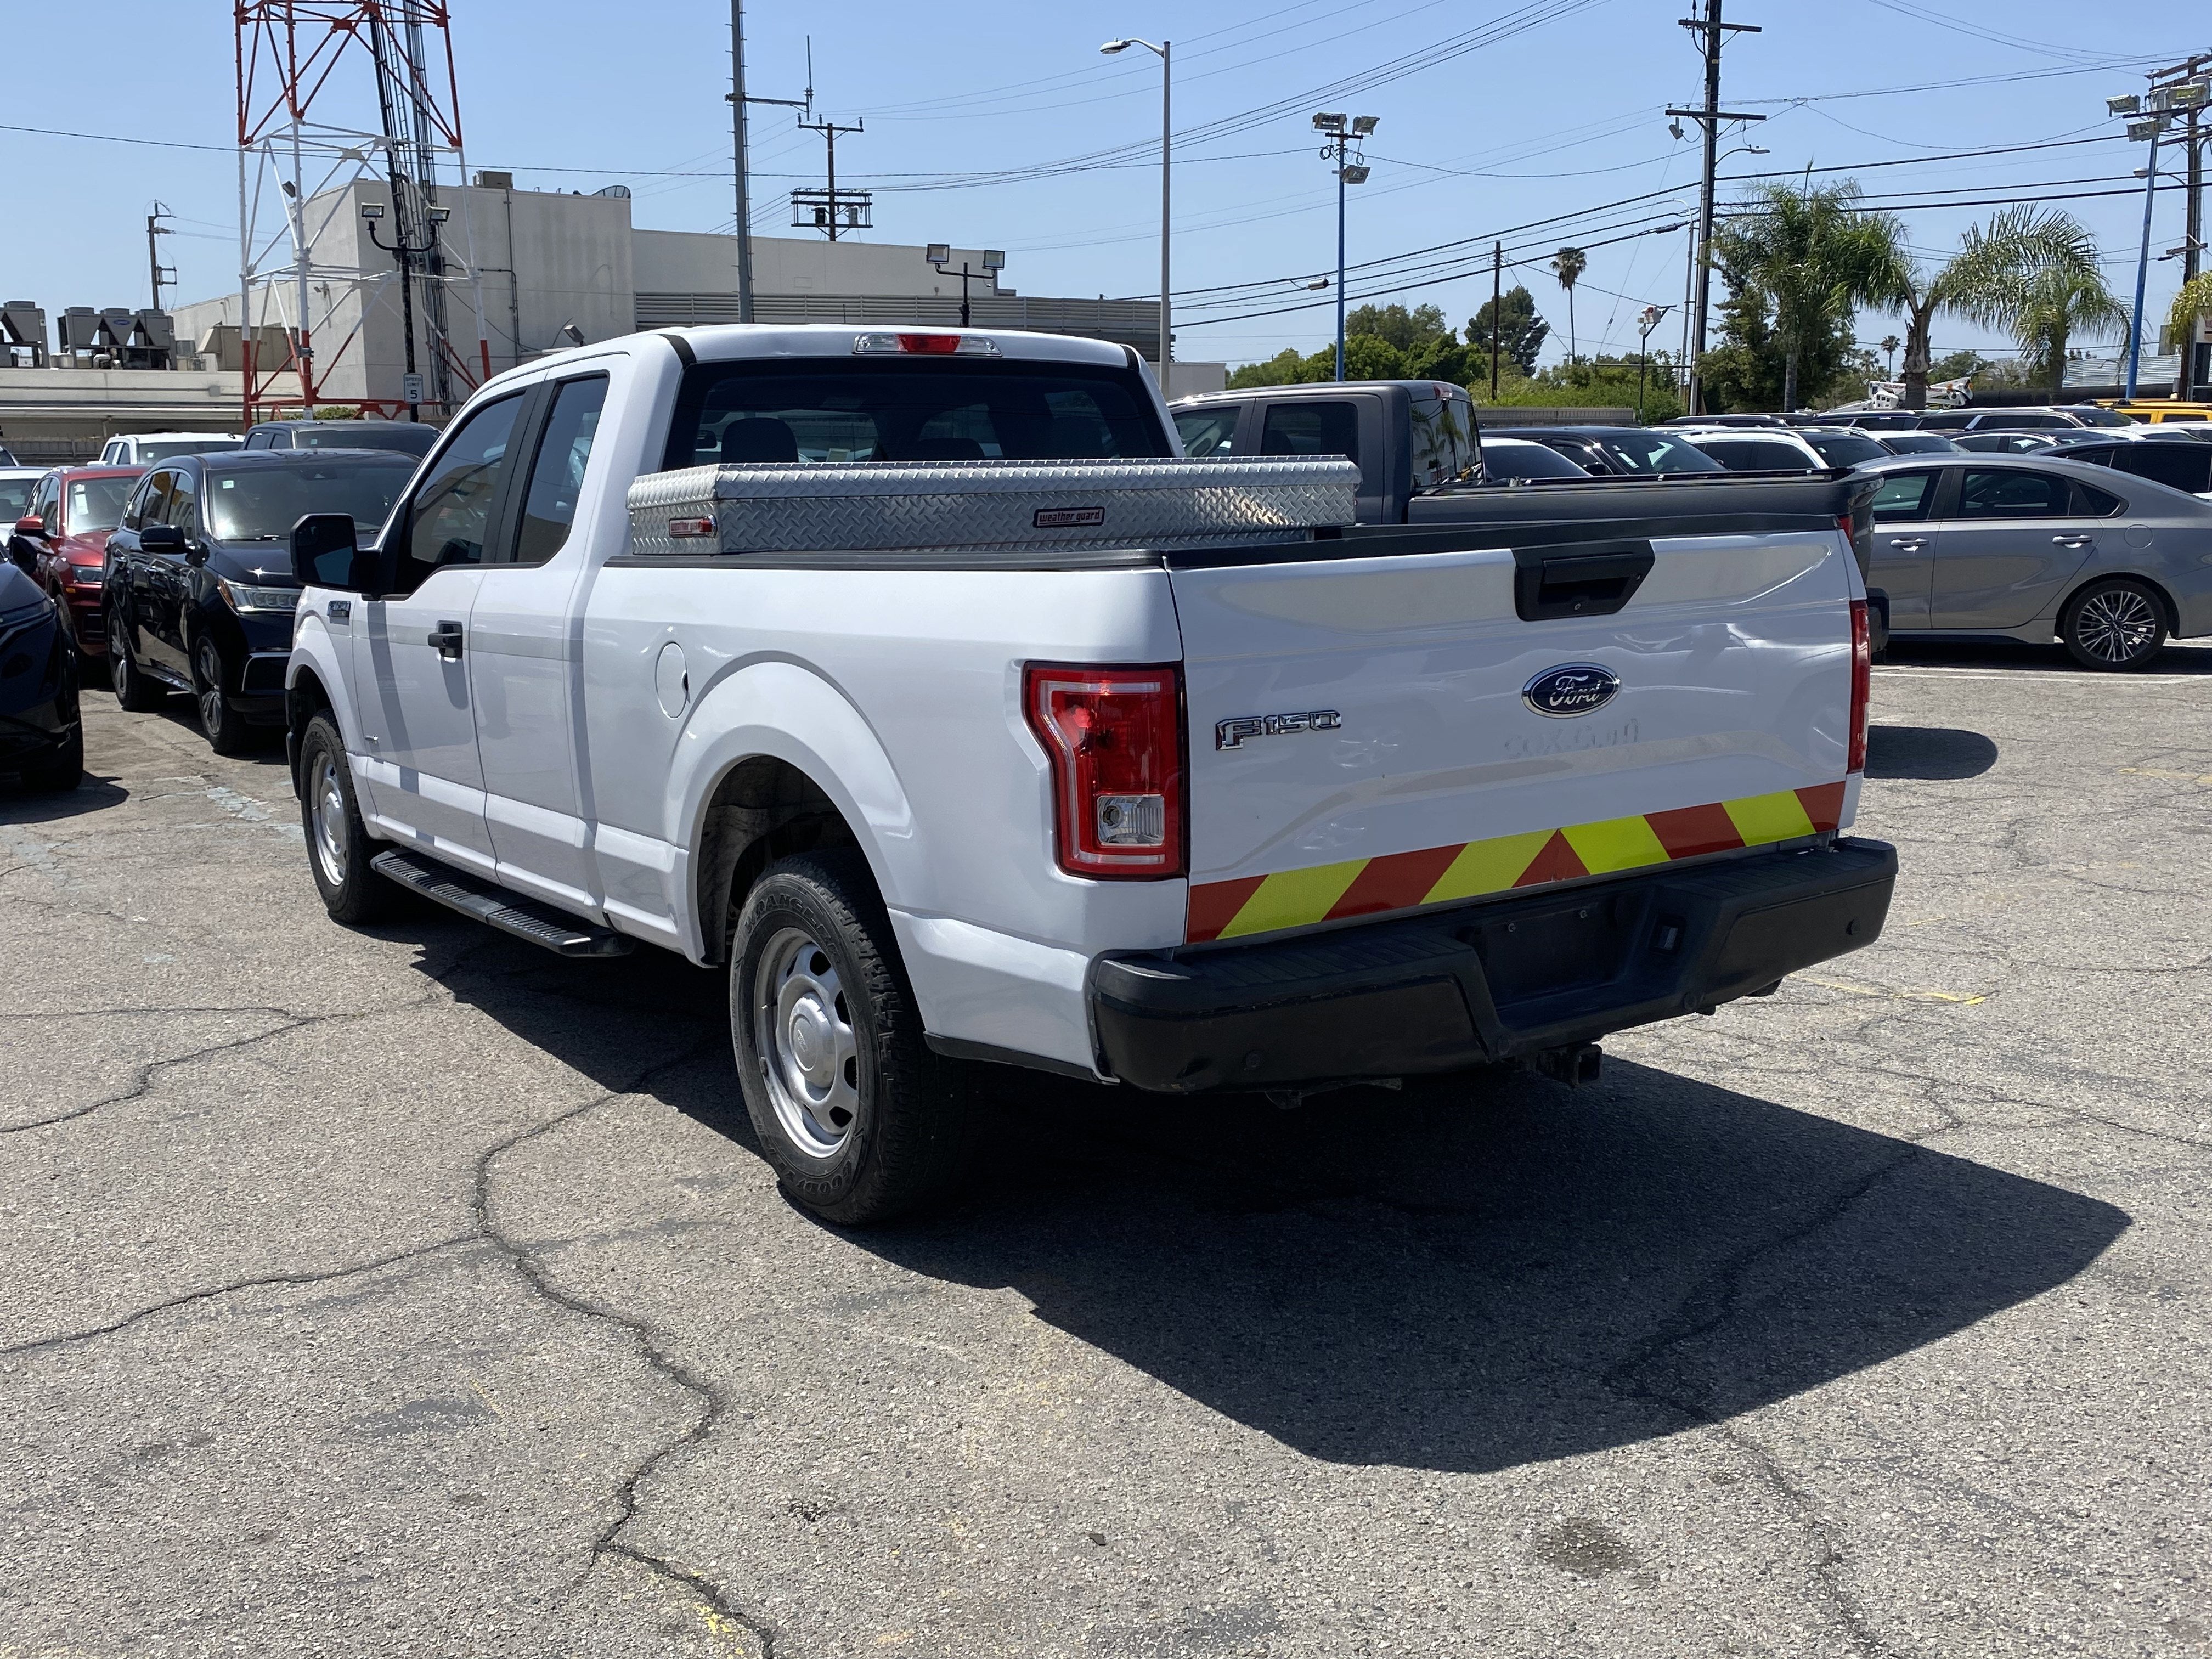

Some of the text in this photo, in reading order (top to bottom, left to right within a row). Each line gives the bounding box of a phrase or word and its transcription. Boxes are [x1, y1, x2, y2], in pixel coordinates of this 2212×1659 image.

[410, 390, 417, 399] 5
[1039, 510, 1100, 522] weather guard
[1549, 675, 1601, 706] Ford
[1216, 709, 1341, 751] F150
